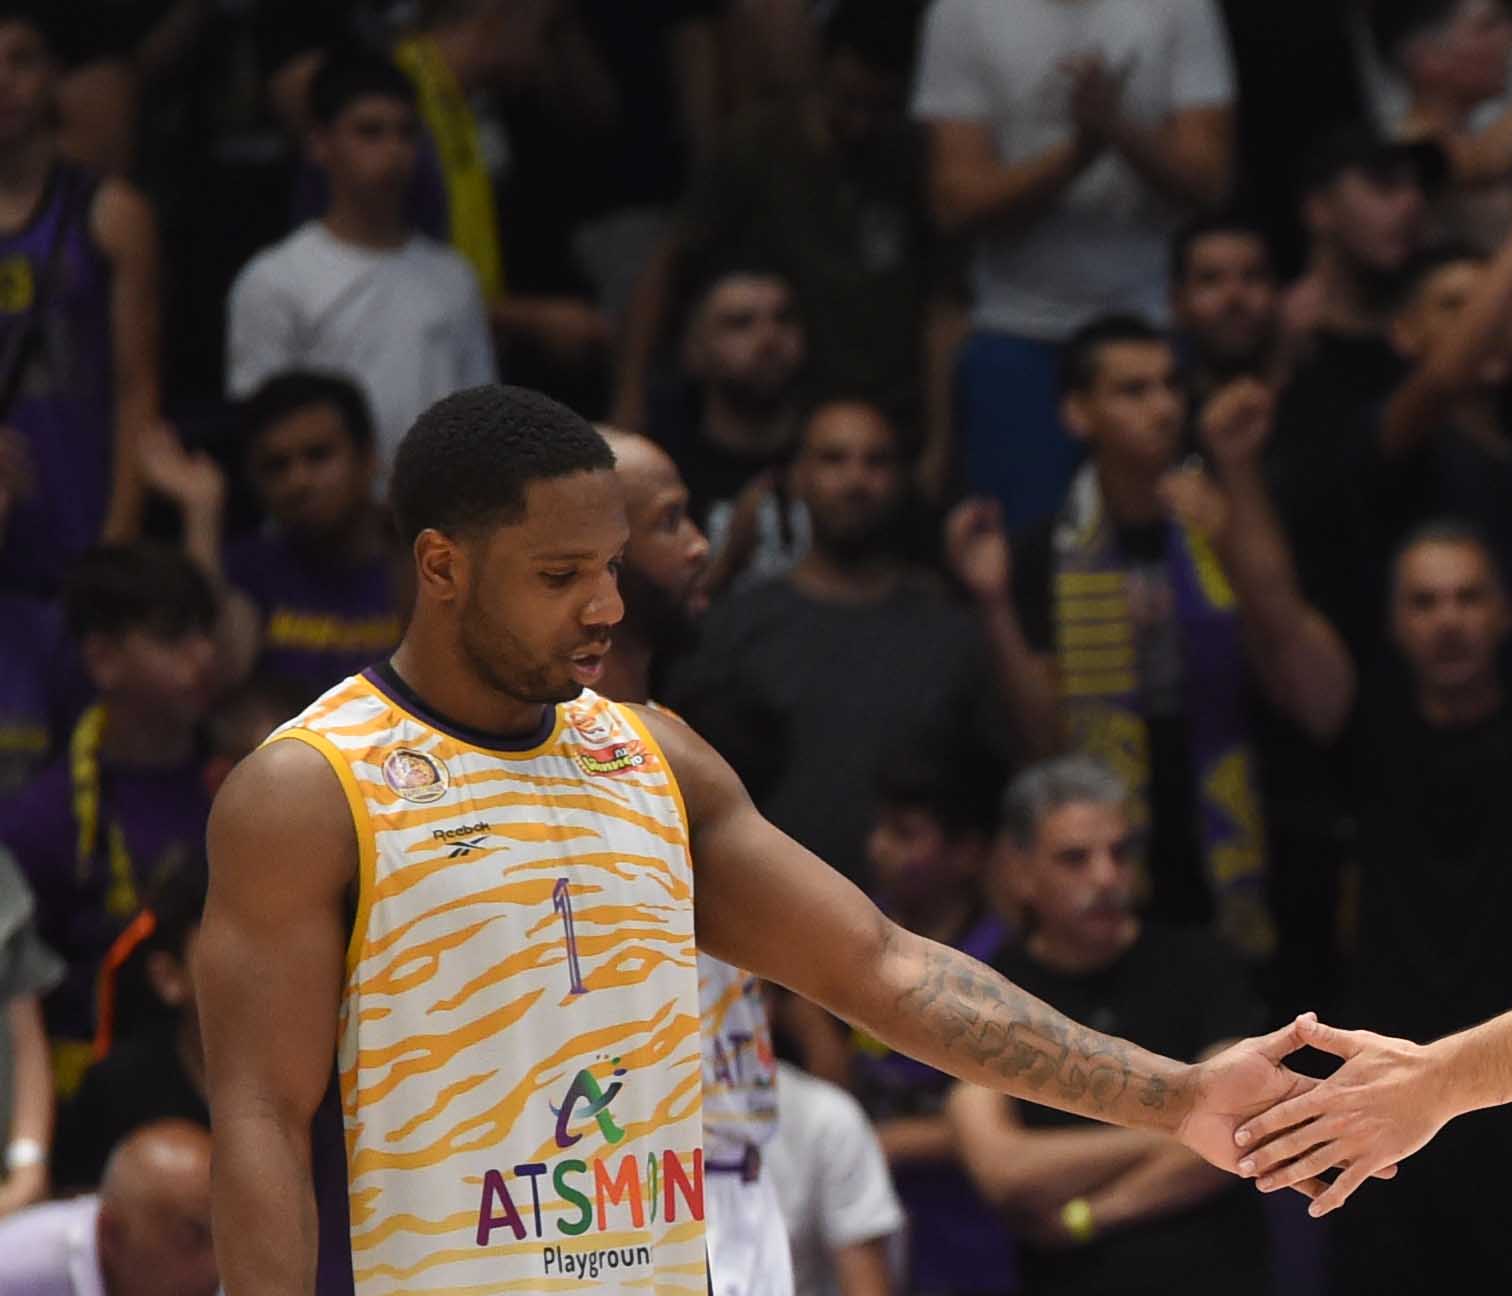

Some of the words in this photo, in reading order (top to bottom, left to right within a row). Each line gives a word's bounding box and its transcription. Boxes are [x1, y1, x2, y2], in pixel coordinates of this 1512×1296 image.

[432, 820, 490, 841] Reebok
[552, 877, 590, 995] 1
[543, 1244, 653, 1280] Playgroun
